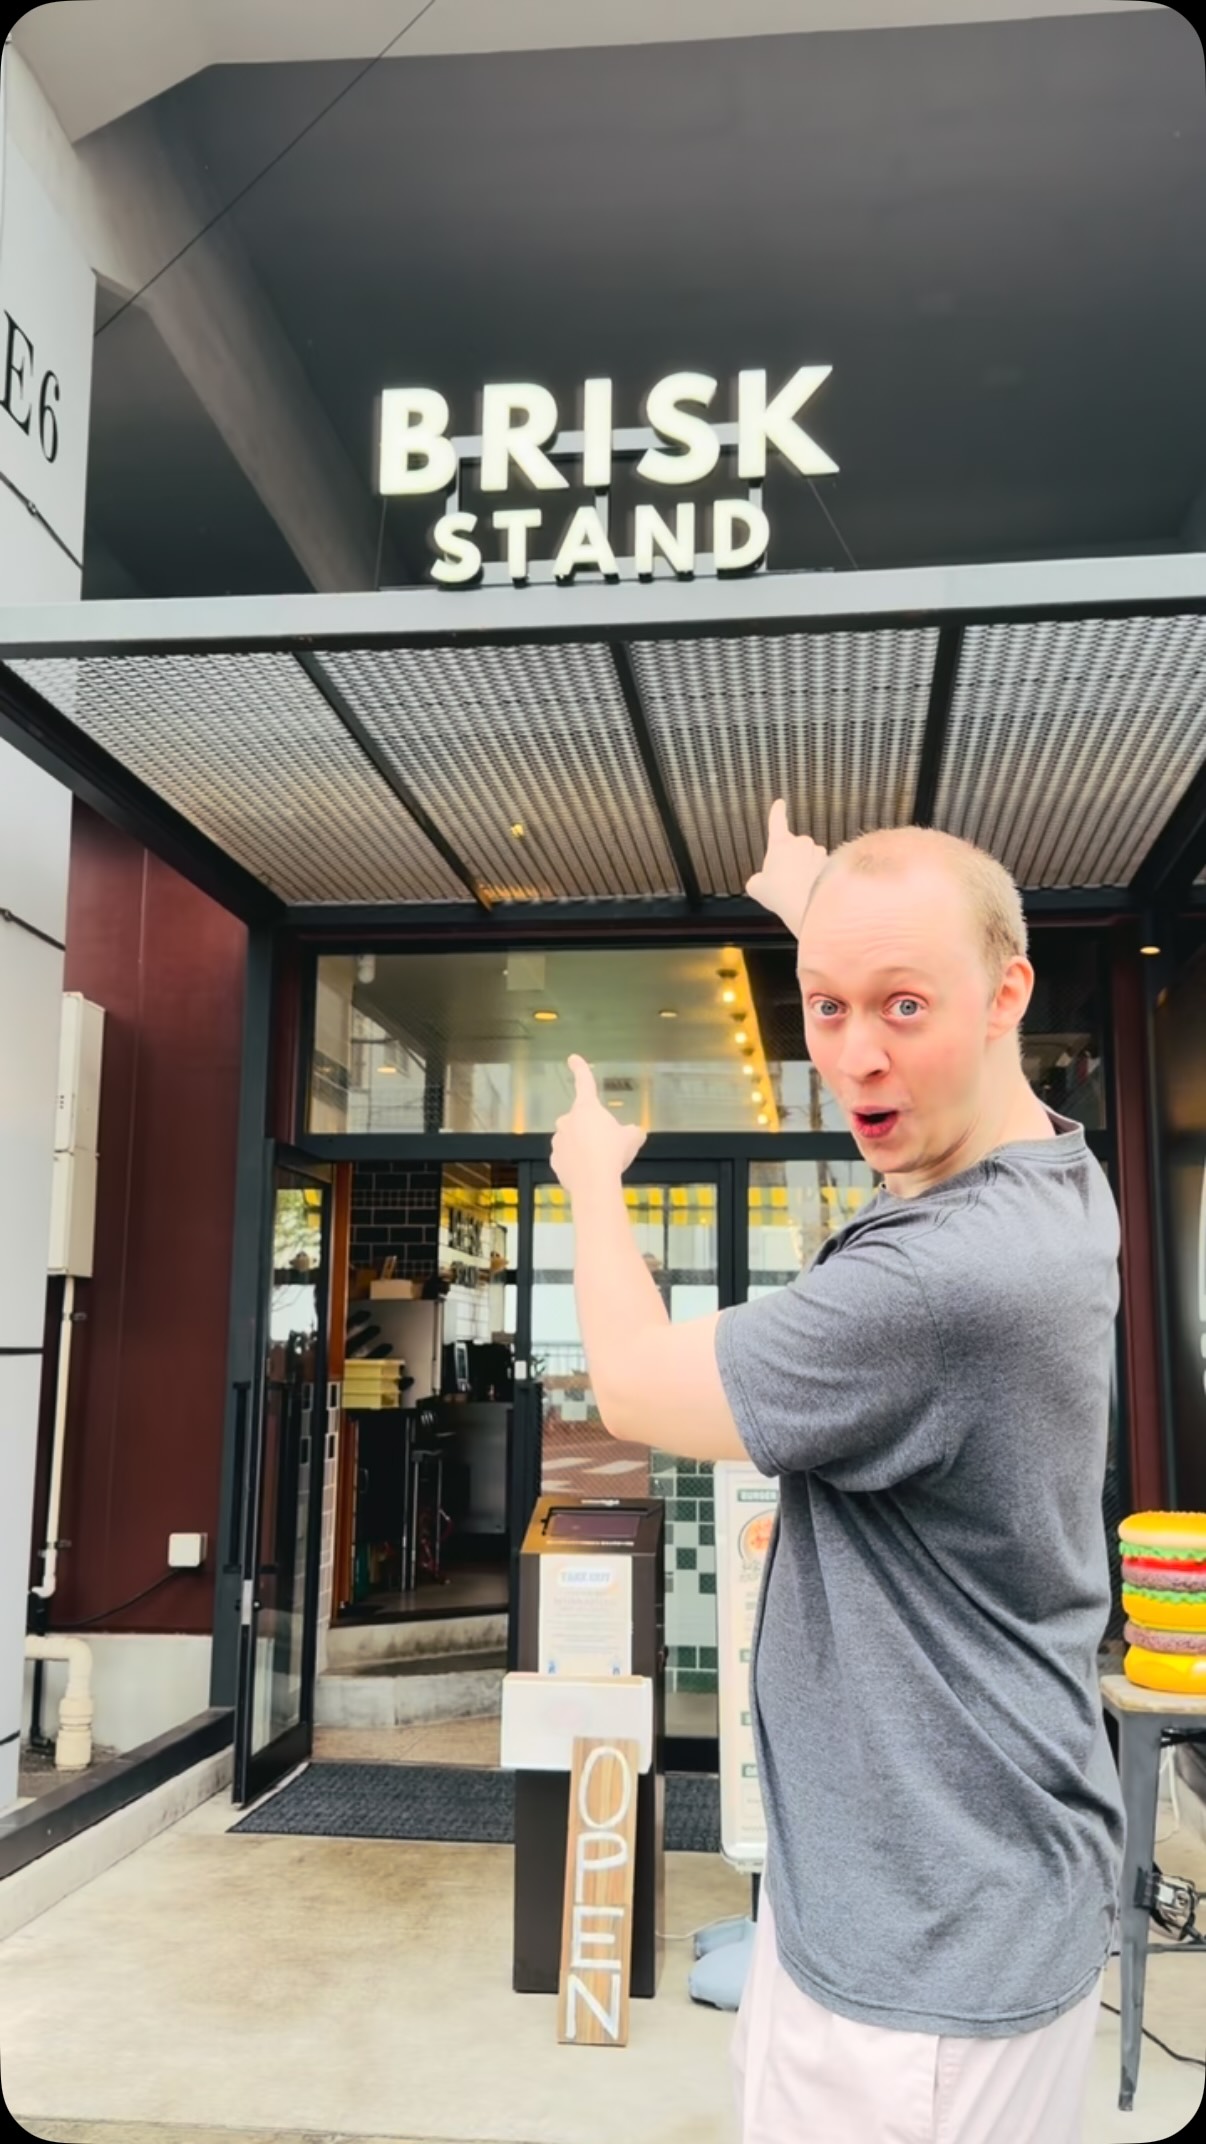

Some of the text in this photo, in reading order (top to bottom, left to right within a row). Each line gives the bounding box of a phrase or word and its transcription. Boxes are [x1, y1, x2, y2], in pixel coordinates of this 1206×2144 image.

[379, 365, 840, 495] BRISK
[430, 499, 770, 584] STAND
[566, 1746, 632, 2040] OPEN
